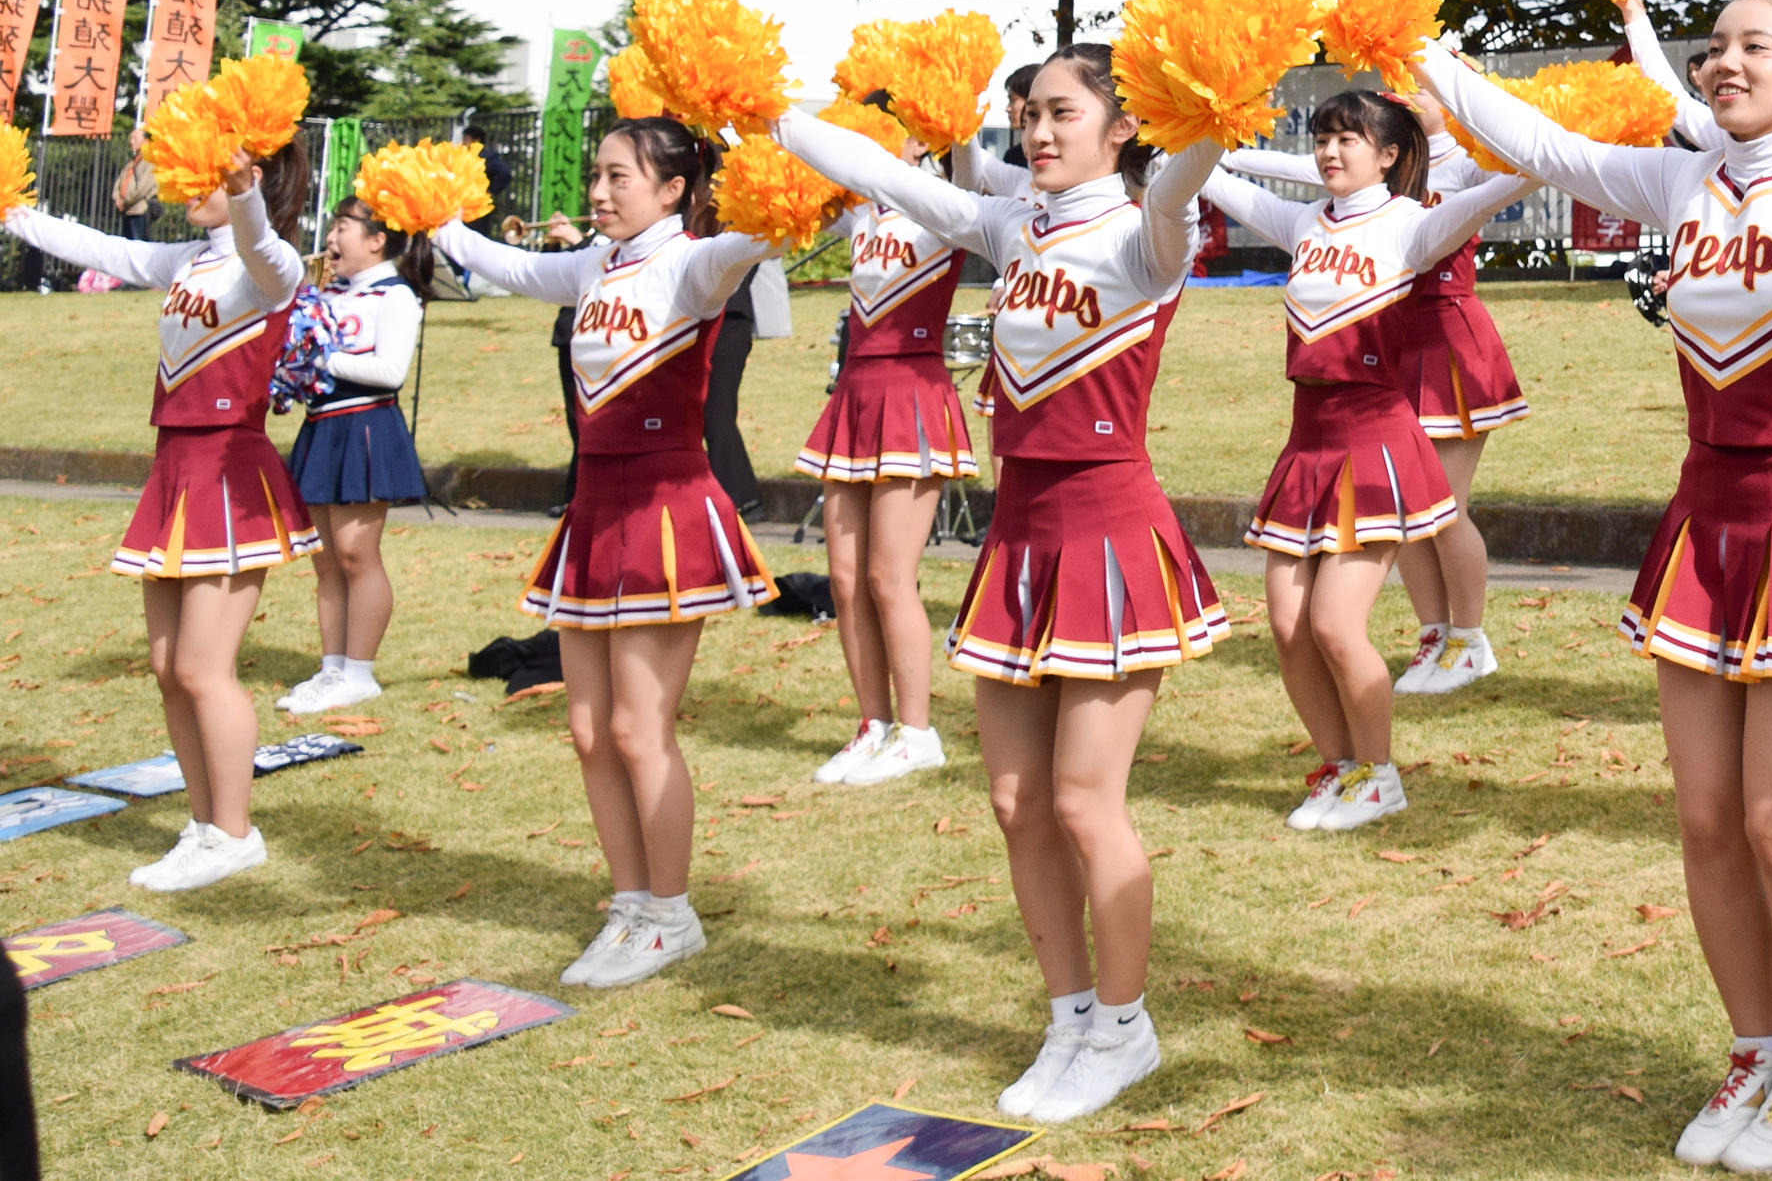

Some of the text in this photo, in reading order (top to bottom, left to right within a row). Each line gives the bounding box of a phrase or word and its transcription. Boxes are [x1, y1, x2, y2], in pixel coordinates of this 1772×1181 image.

[997, 258, 1102, 329] Leaps
[1286, 239, 1376, 287] Leaps
[288, 994, 500, 1073] 城
